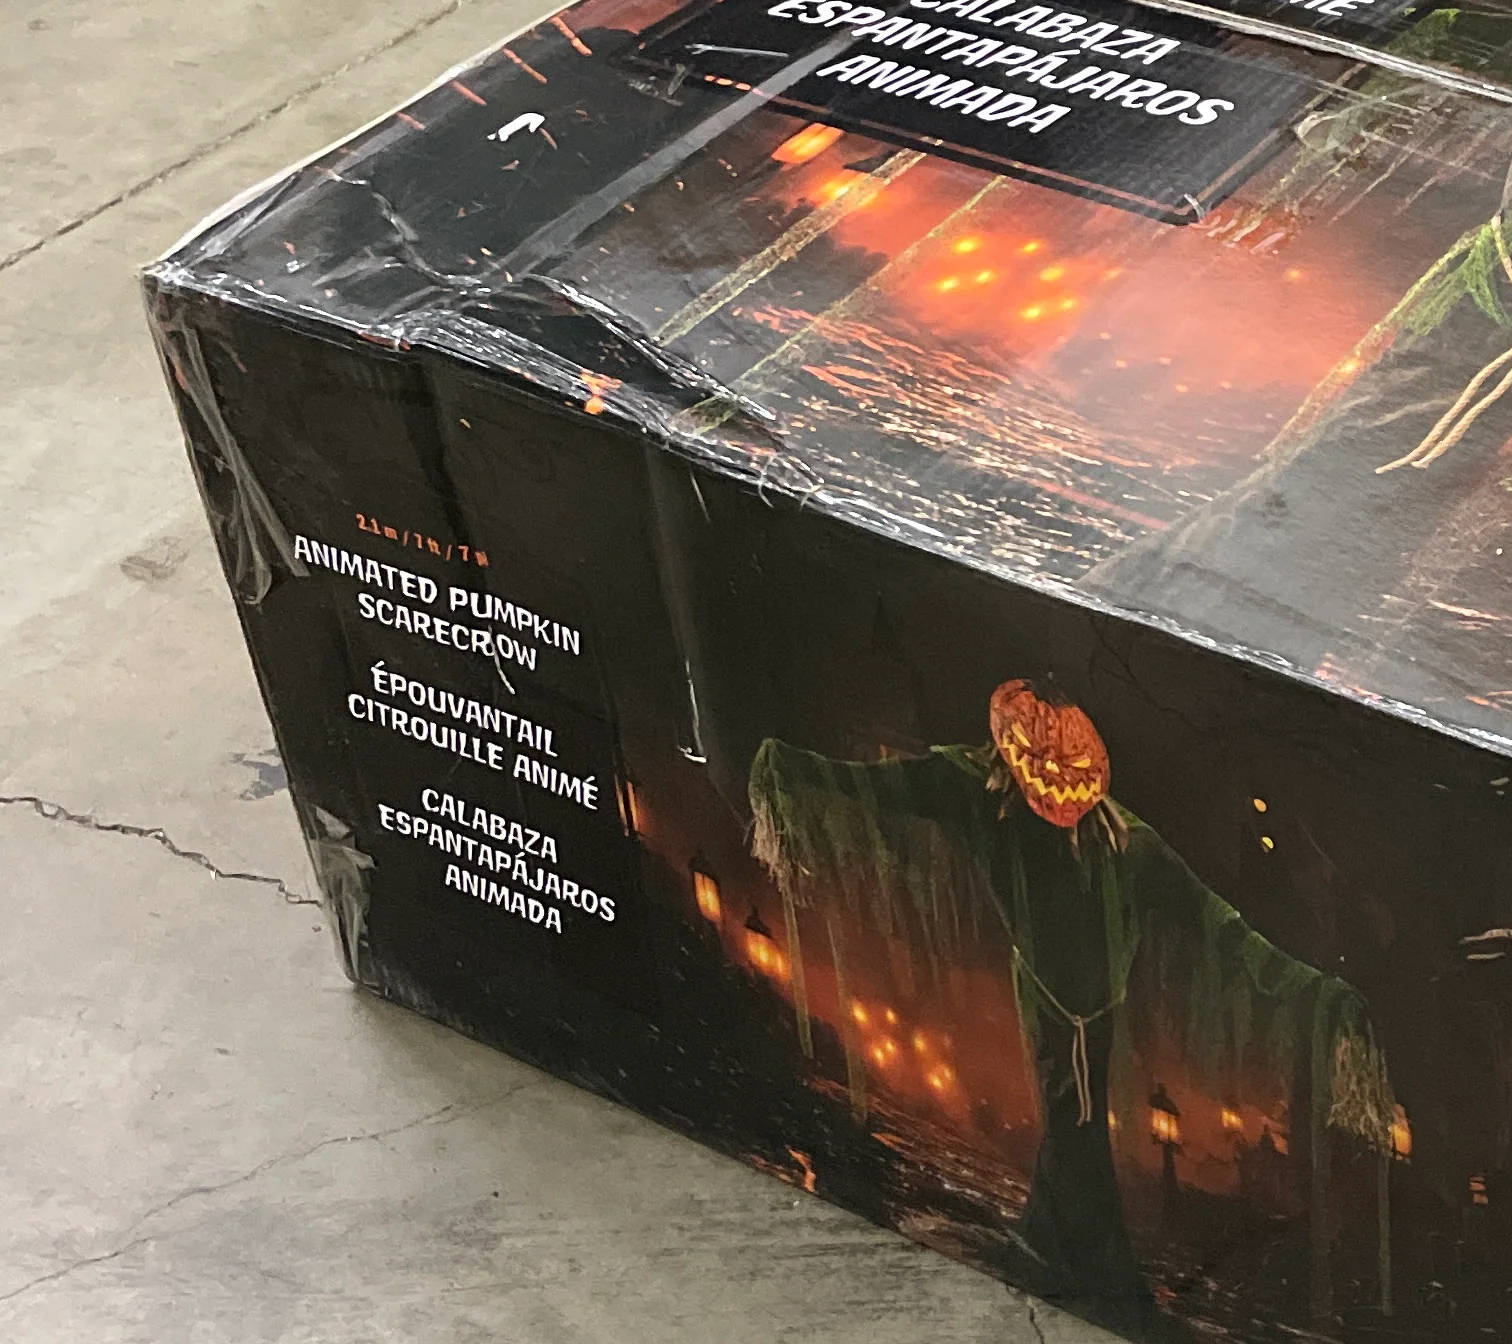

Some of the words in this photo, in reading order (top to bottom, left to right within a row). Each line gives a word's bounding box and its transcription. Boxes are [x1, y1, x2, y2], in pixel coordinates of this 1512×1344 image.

[816, 55, 1071, 133] ANIMADA
[295, 535, 437, 603] ANIMATED
[450, 587, 579, 655] PUMPKIN
[359, 593, 536, 670] SCARECROW
[349, 694, 503, 769] CITROUILLE
[514, 755, 598, 809] ANIMÉ
[371, 661, 557, 756] ÉPOUVANTAIL
[379, 804, 614, 921] ESPANTAPÁJAROS
[423, 789, 556, 863] CALABAZA
[446, 865, 561, 933] ANIMADA
